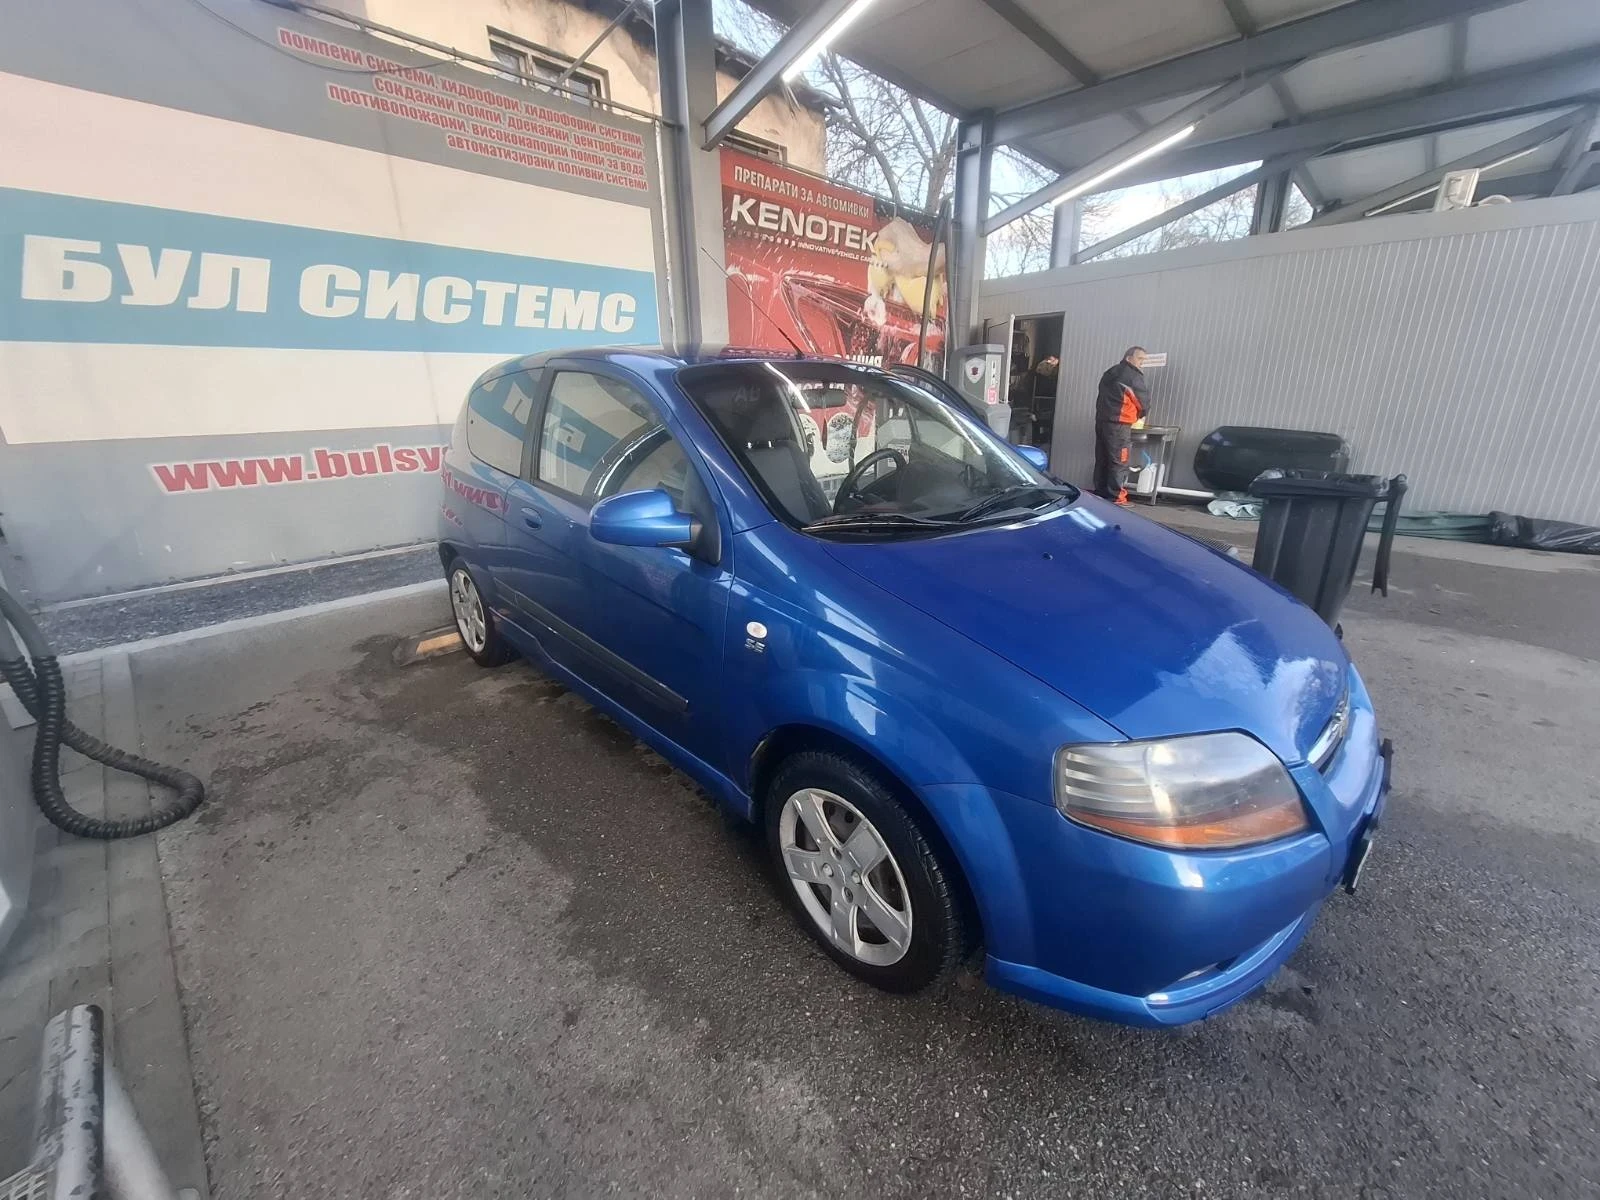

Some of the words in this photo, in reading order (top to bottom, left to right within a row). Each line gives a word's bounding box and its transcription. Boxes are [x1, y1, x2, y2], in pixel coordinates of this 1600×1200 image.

[279, 29, 363, 66] помпени
[607, 159, 619, 170] за
[734, 165, 799, 199] ПРЕПАРАТИ
[800, 187, 814, 203] ЗА
[815, 193, 869, 218] АВТОМИВКИ
[730, 194, 877, 252] KENOTEK
[22, 234, 271, 313] БУЛ
[299, 264, 637, 333] СИСТЕМС
[153, 445, 449, 493] www.bulsy
